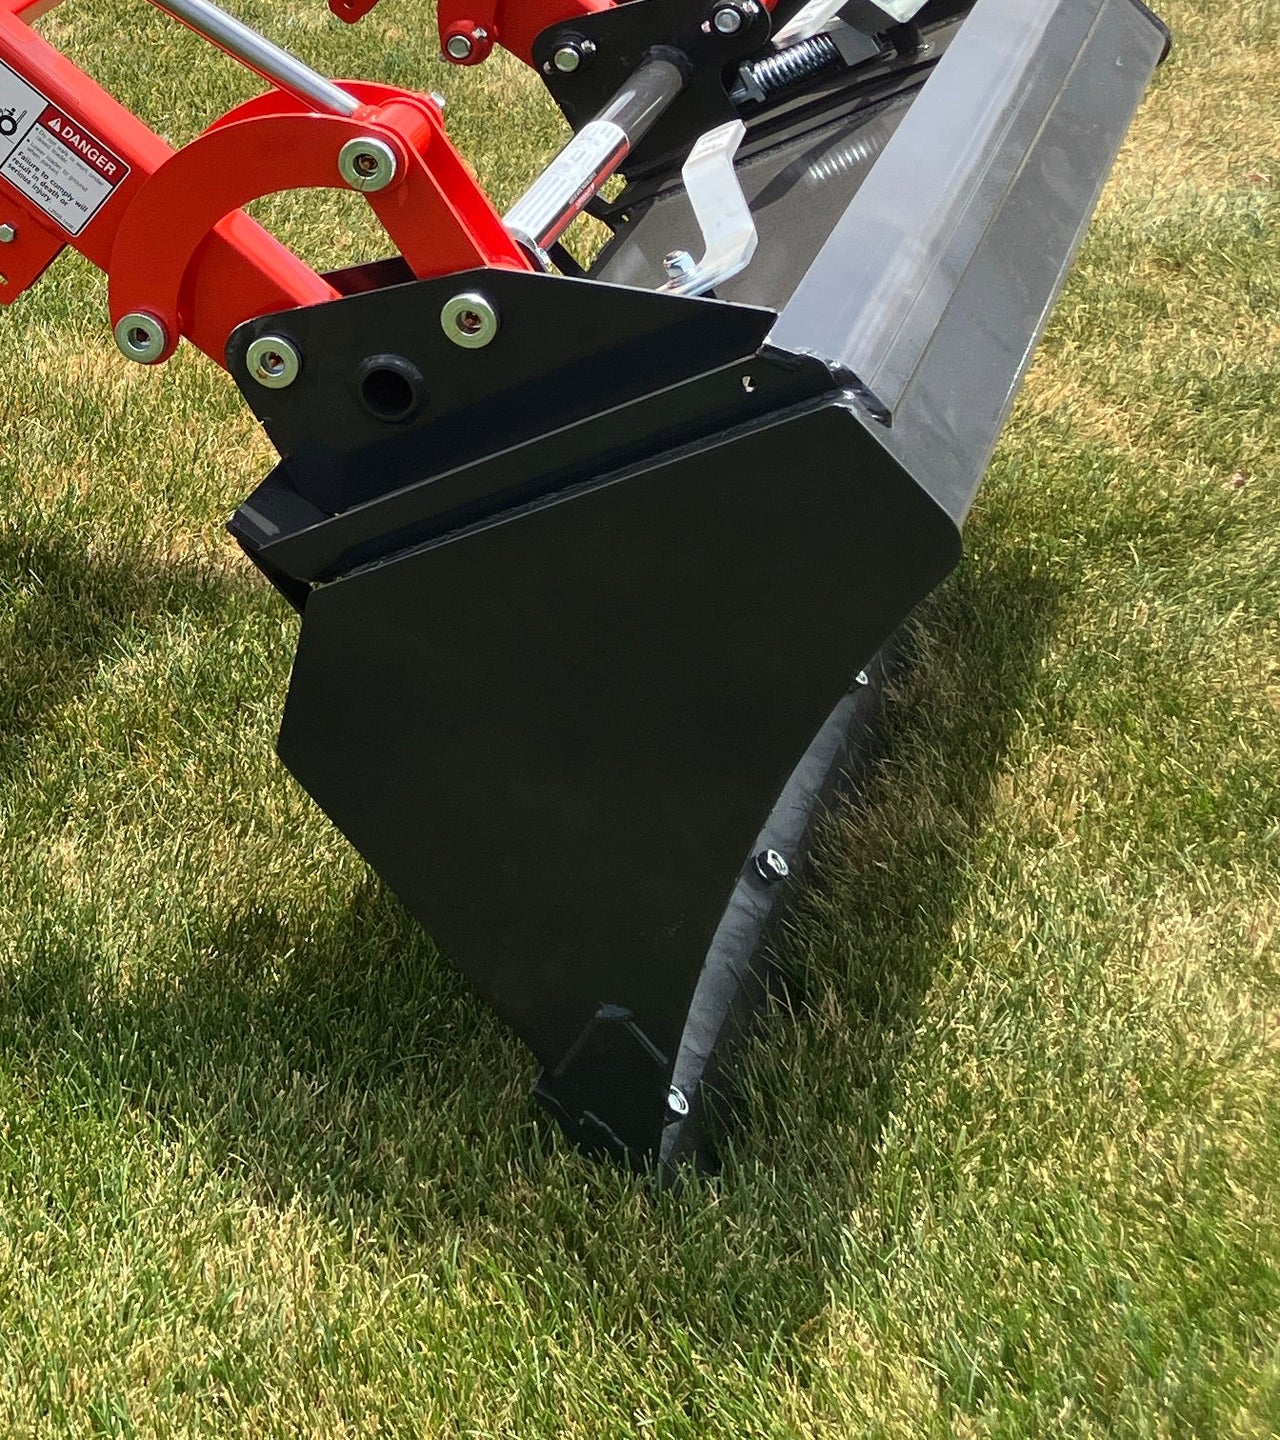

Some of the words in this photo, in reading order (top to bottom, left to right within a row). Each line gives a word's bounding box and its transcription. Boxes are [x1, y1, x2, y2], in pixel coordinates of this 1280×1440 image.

[7, 162, 32, 186] serious
[61, 126, 117, 177] DANGER
[12, 156, 32, 176] result
[40, 180, 60, 200] death
[17, 150, 40, 173] Failure
[40, 171, 50, 181] to
[49, 178, 75, 202] comply
[74, 200, 89, 213] will
